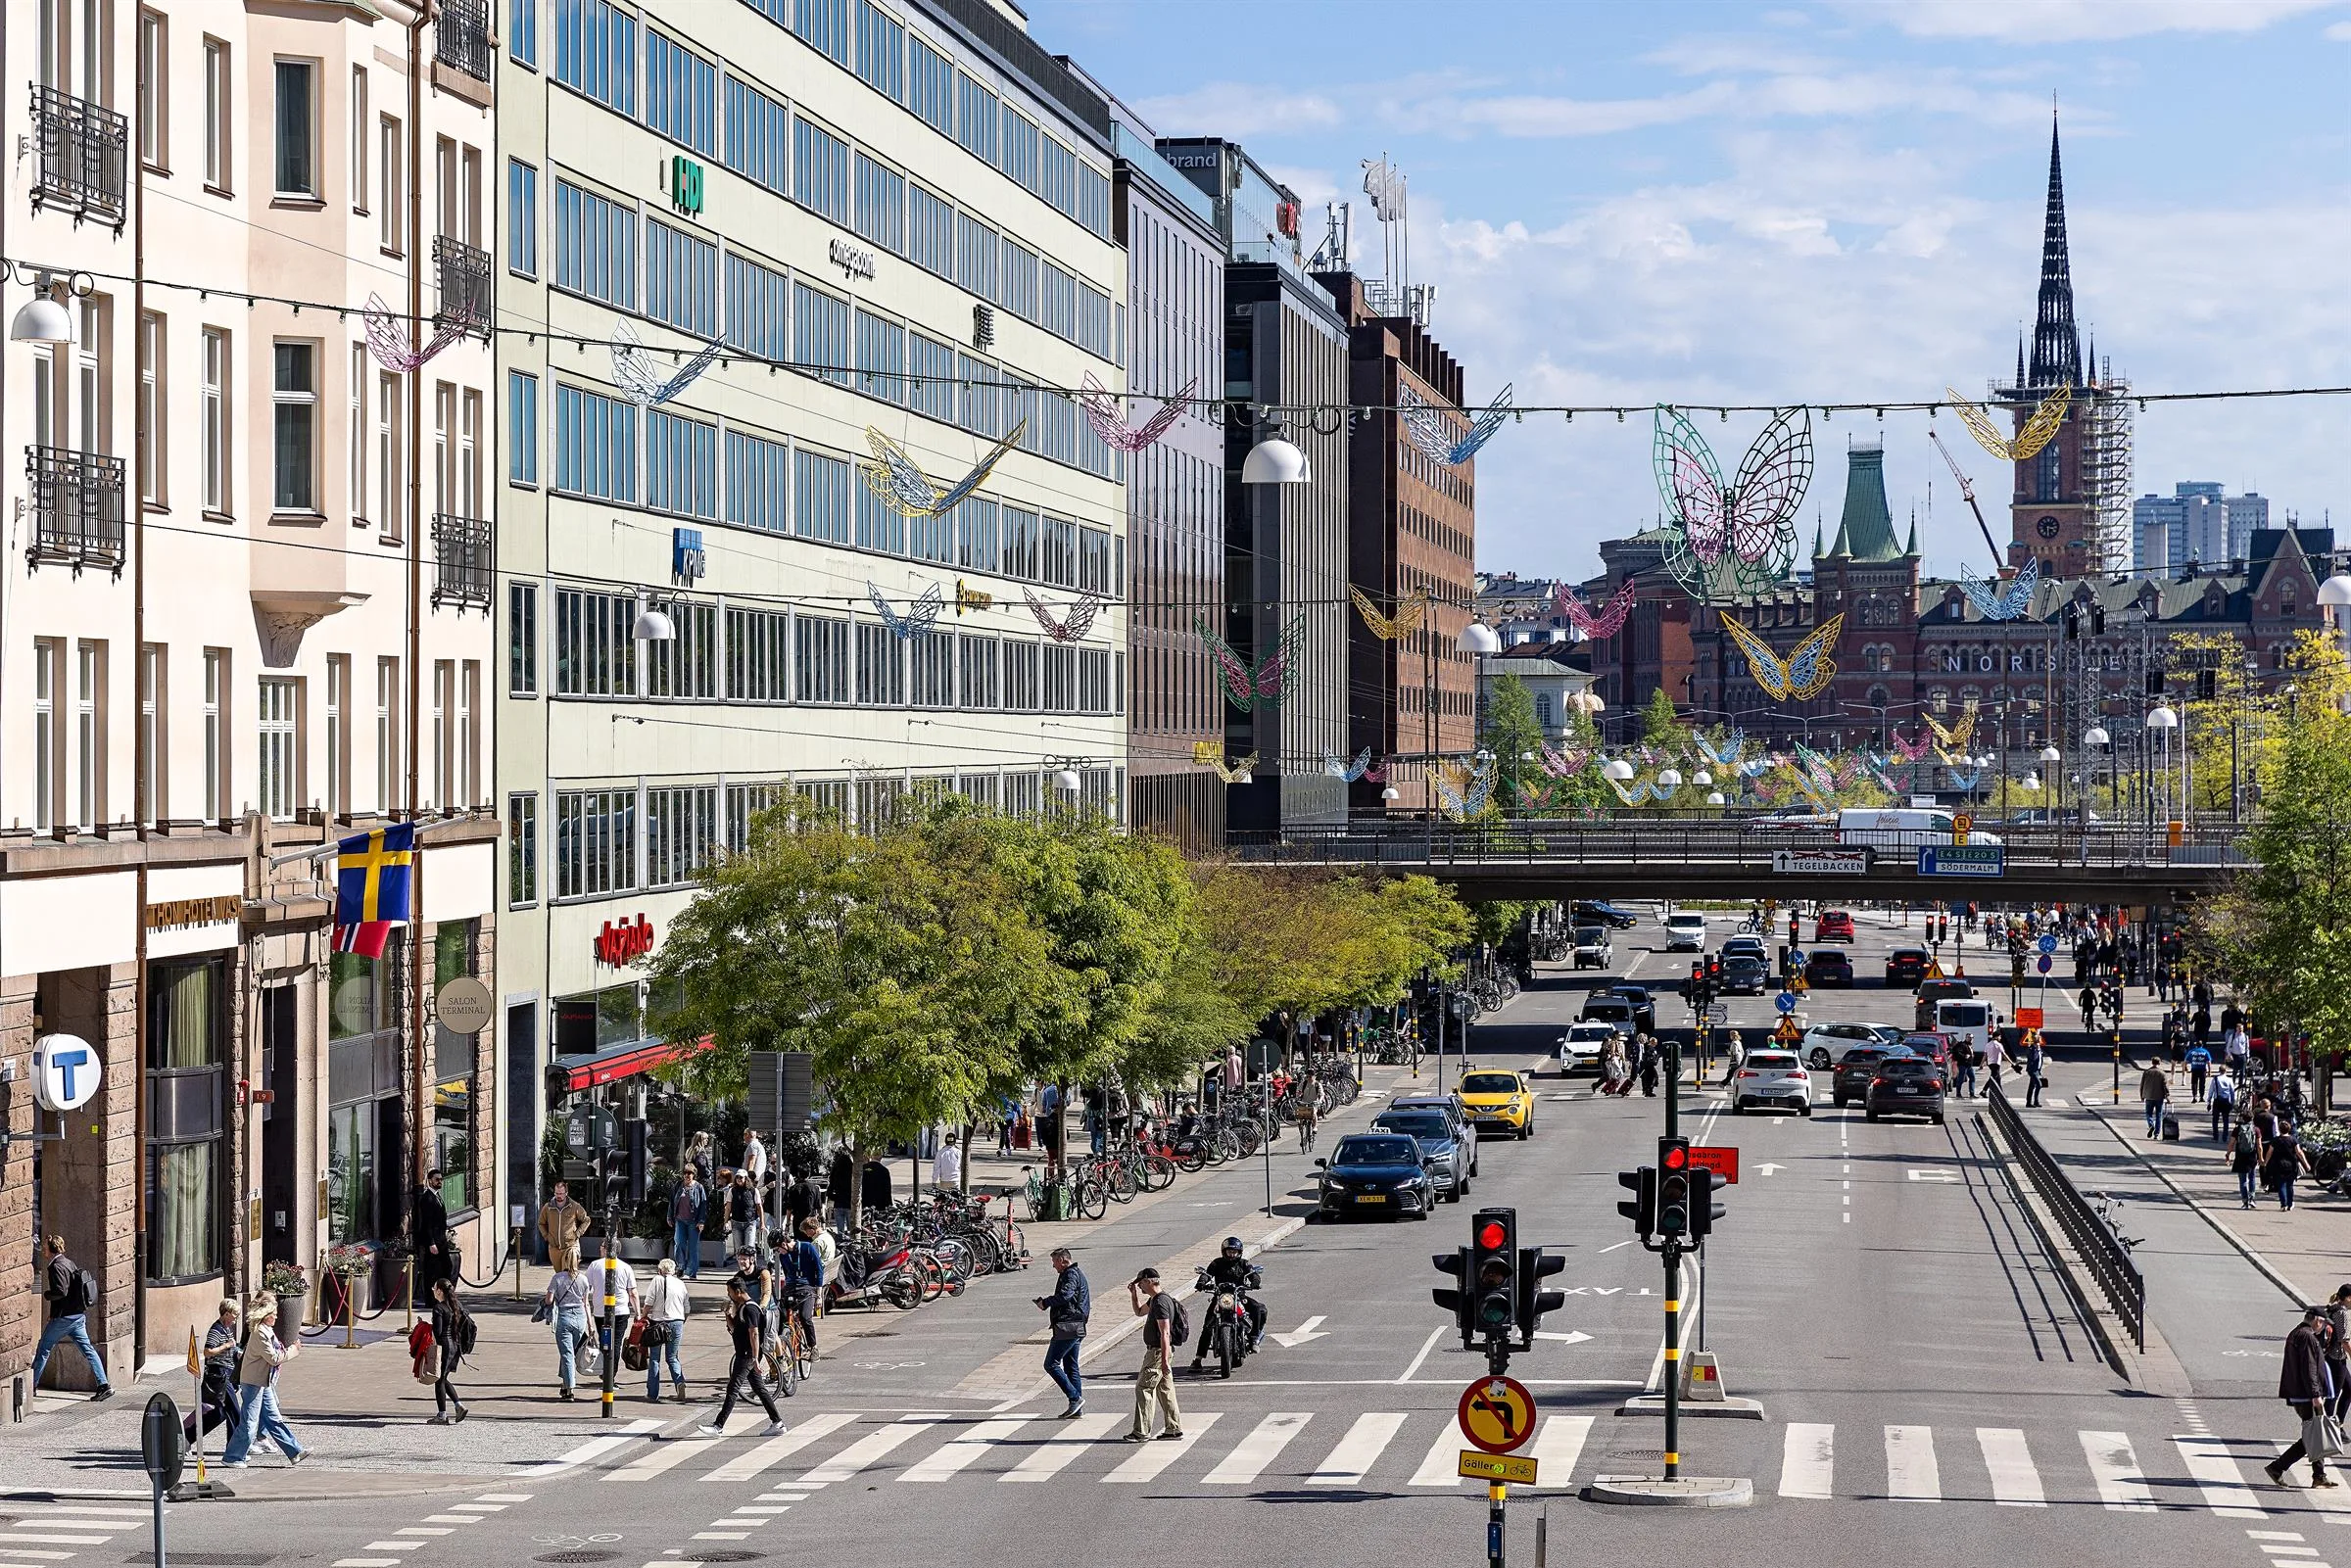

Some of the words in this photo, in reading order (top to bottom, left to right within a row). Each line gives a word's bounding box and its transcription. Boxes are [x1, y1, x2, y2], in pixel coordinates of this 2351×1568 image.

[674, 156, 703, 214] HDI
[683, 548, 705, 578] KPMG
[1958, 834, 1964, 844] E
[1793, 862, 1863, 871] TEGELBACKEN
[1941, 862, 1994, 872] SÖDERMALM
[150, 901, 179, 927] THON
[595, 913, 654, 970] VAPIANO
[448, 996, 477, 1005] SALON
[440, 1006, 486, 1015] TERMINAL
[52, 1049, 88, 1102] T
[1463, 1458, 1494, 1470] Gäller
